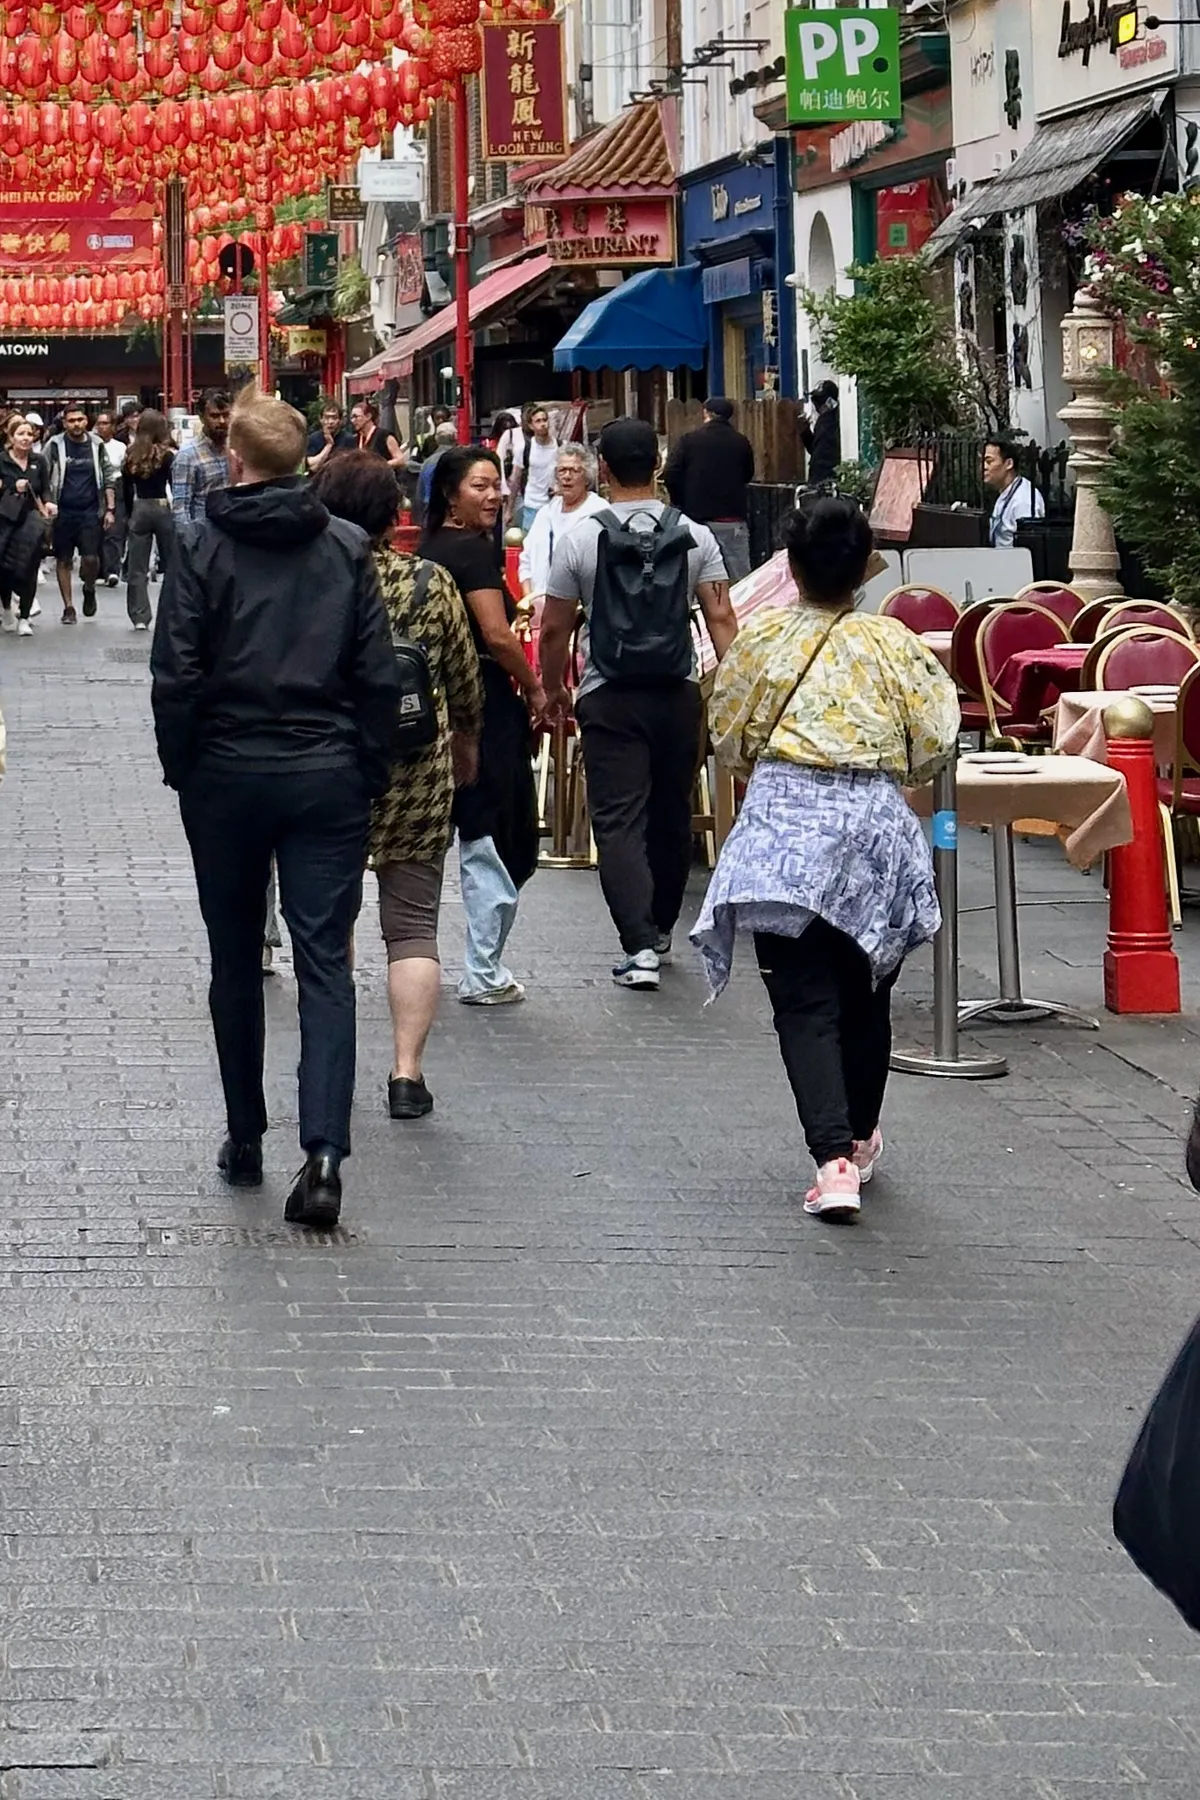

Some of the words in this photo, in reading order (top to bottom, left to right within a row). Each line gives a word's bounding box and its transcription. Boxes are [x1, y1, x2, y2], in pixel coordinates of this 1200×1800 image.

[506, 29, 542, 126] 新龍鳳
[513, 129, 544, 142] NEW
[529, 141, 563, 154] FUNG
[0, 191, 21, 203] HEI
[23, 191, 47, 203] FAT
[48, 190, 82, 203] CHOY
